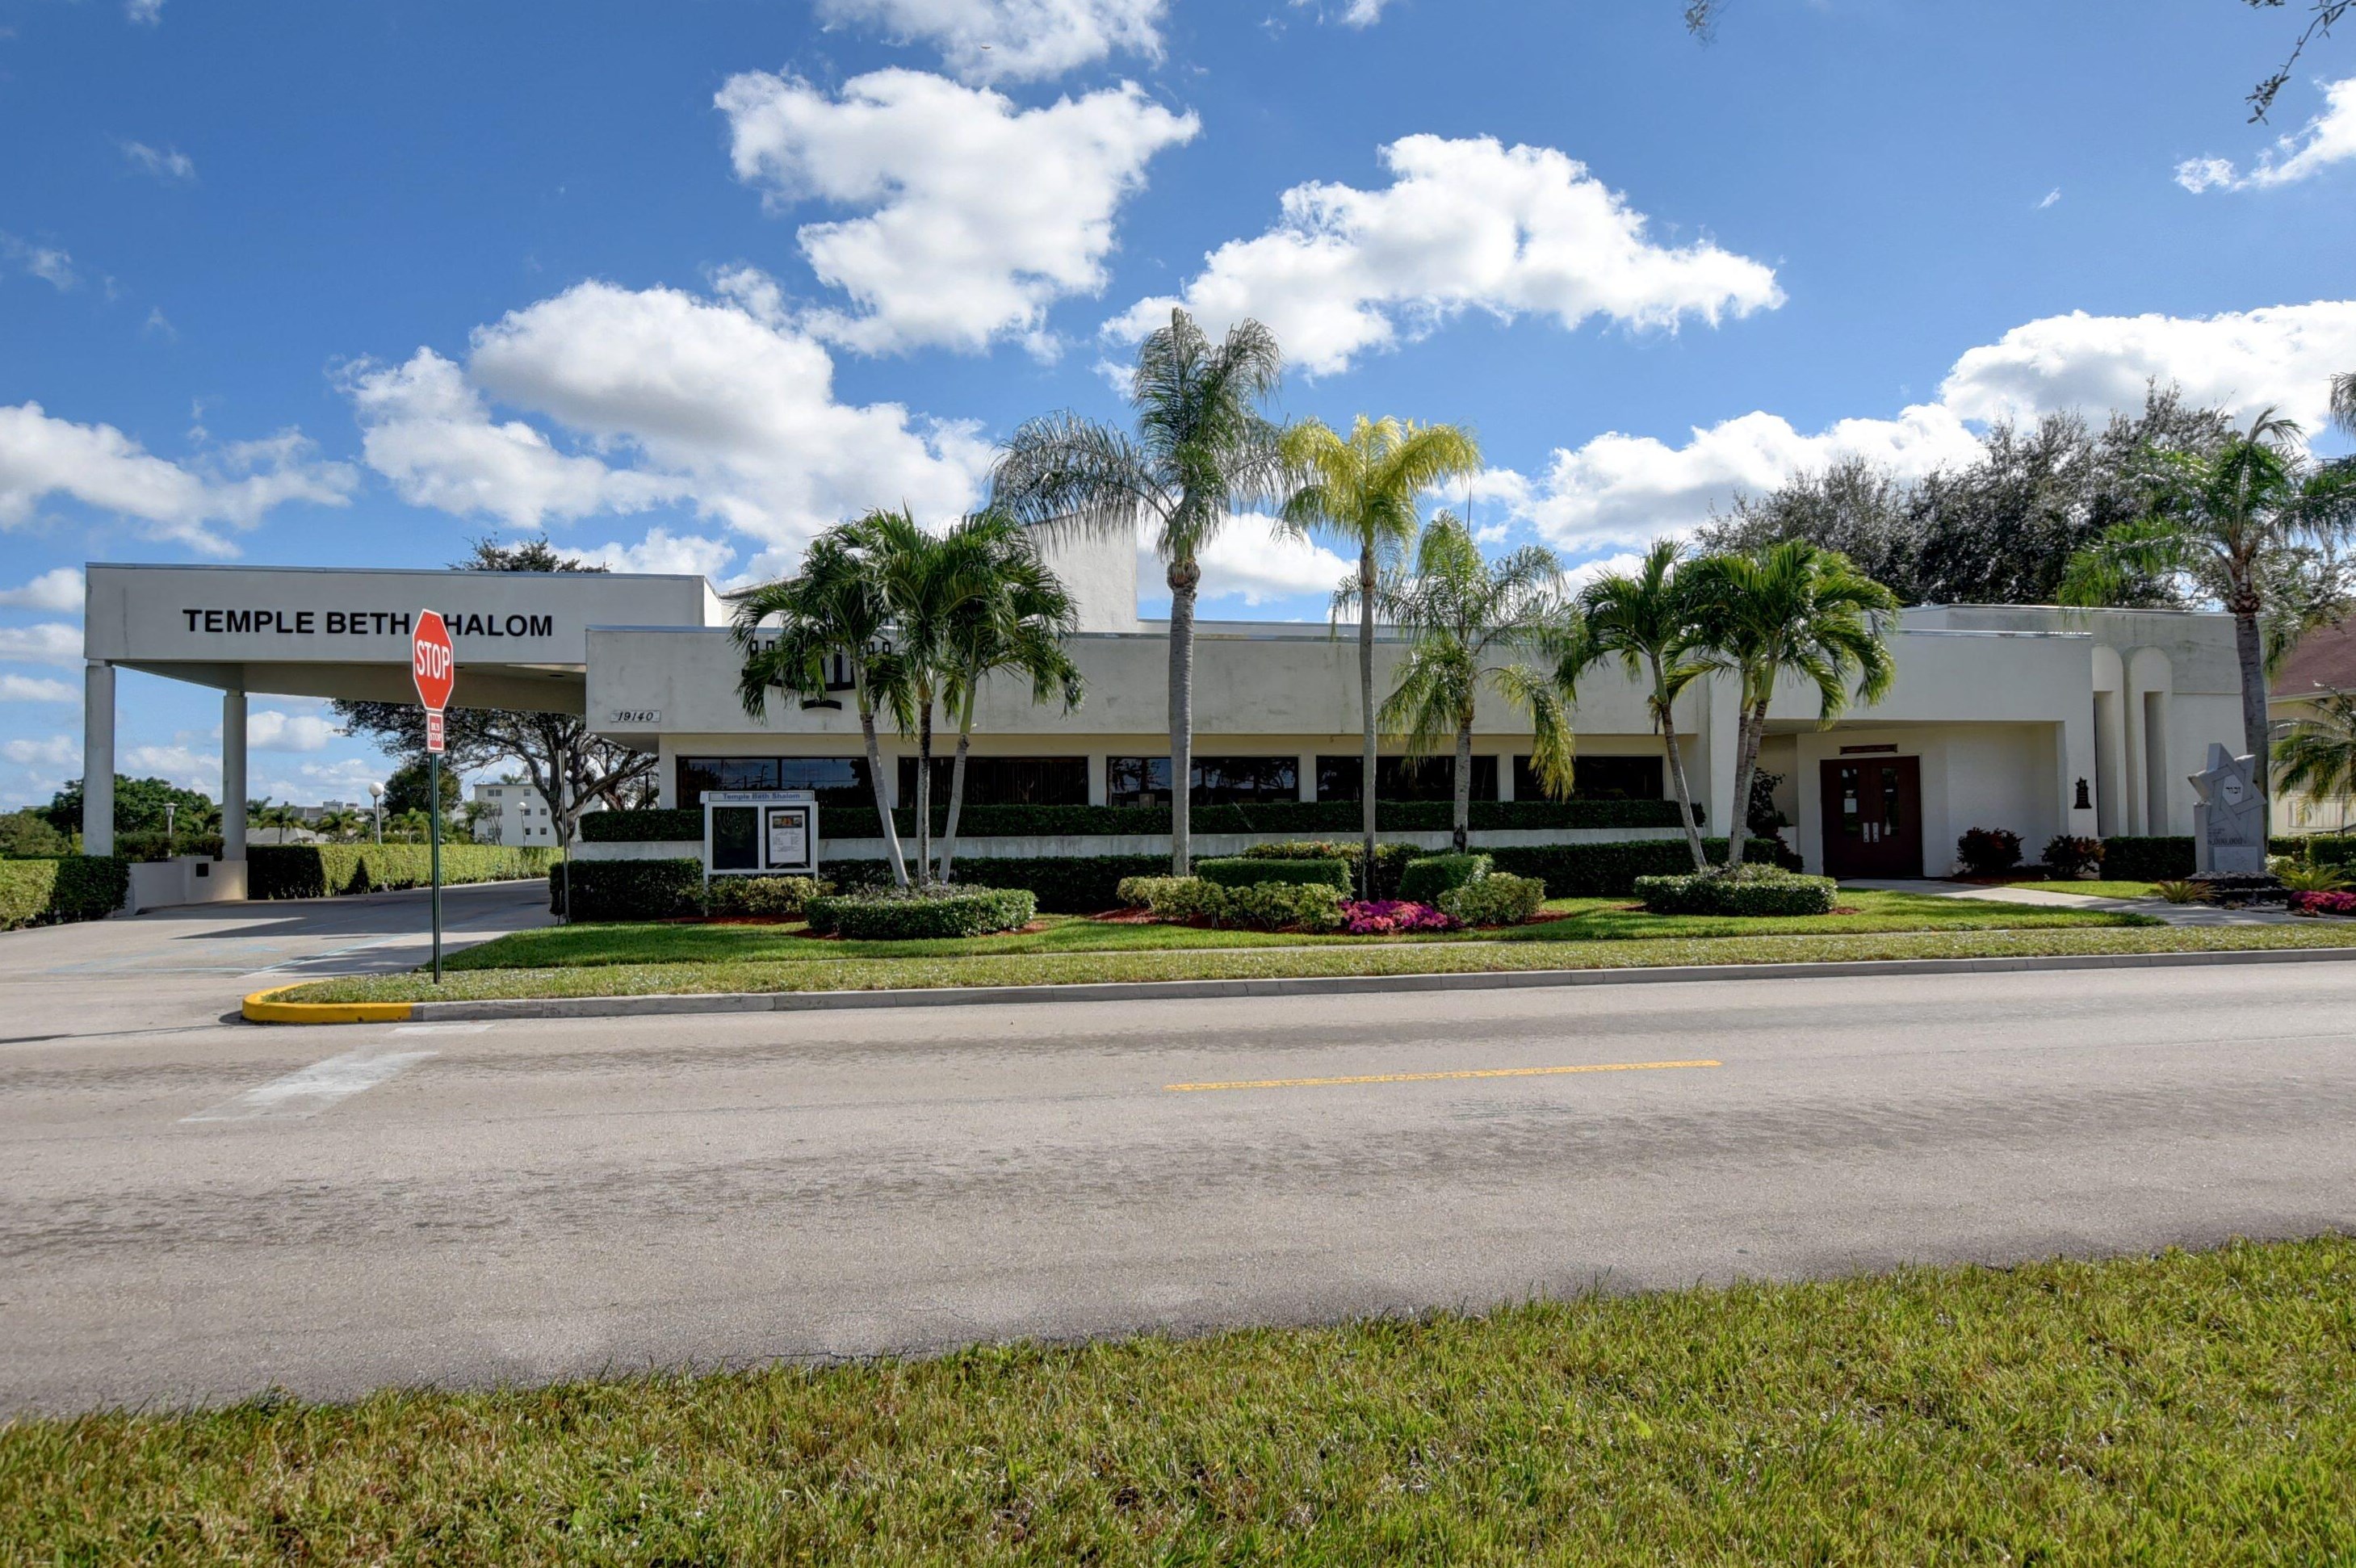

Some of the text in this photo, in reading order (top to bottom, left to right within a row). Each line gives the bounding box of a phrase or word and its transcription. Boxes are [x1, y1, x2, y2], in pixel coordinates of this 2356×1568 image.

[182, 609, 553, 637] TEMPLE BETH HALOM
[416, 639, 451, 680] STOP
[618, 711, 654, 721] 19140
[430, 722, 440, 732] BUS
[430, 732, 442, 742] STOP
